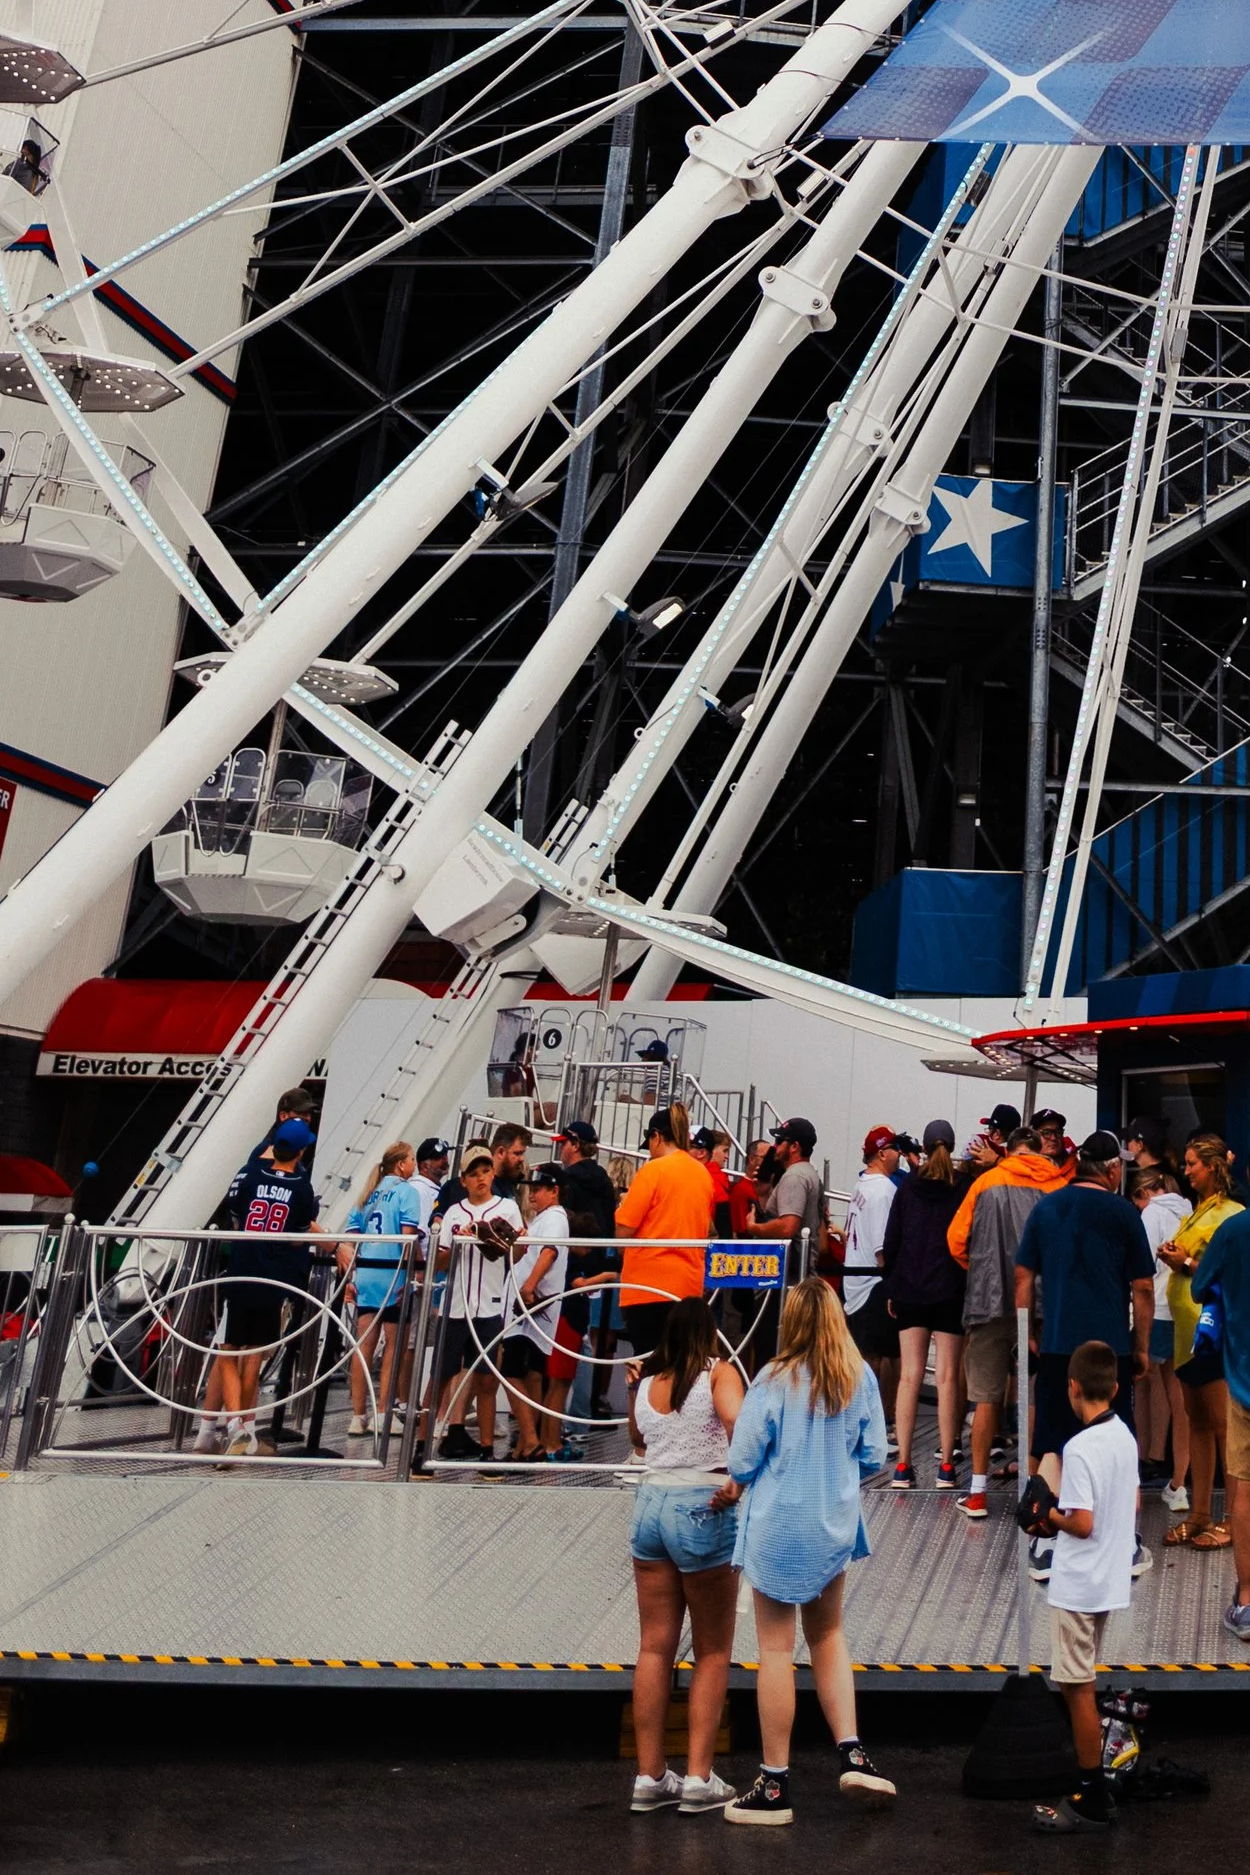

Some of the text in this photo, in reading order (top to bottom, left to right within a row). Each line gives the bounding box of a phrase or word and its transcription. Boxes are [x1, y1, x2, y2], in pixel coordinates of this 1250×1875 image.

[548, 1029, 557, 1047] 6
[52, 1055, 233, 1076] Elevator Accs
[256, 1184, 293, 1203] OLSON
[245, 1199, 290, 1233] 28
[708, 1252, 780, 1278] ENTER
